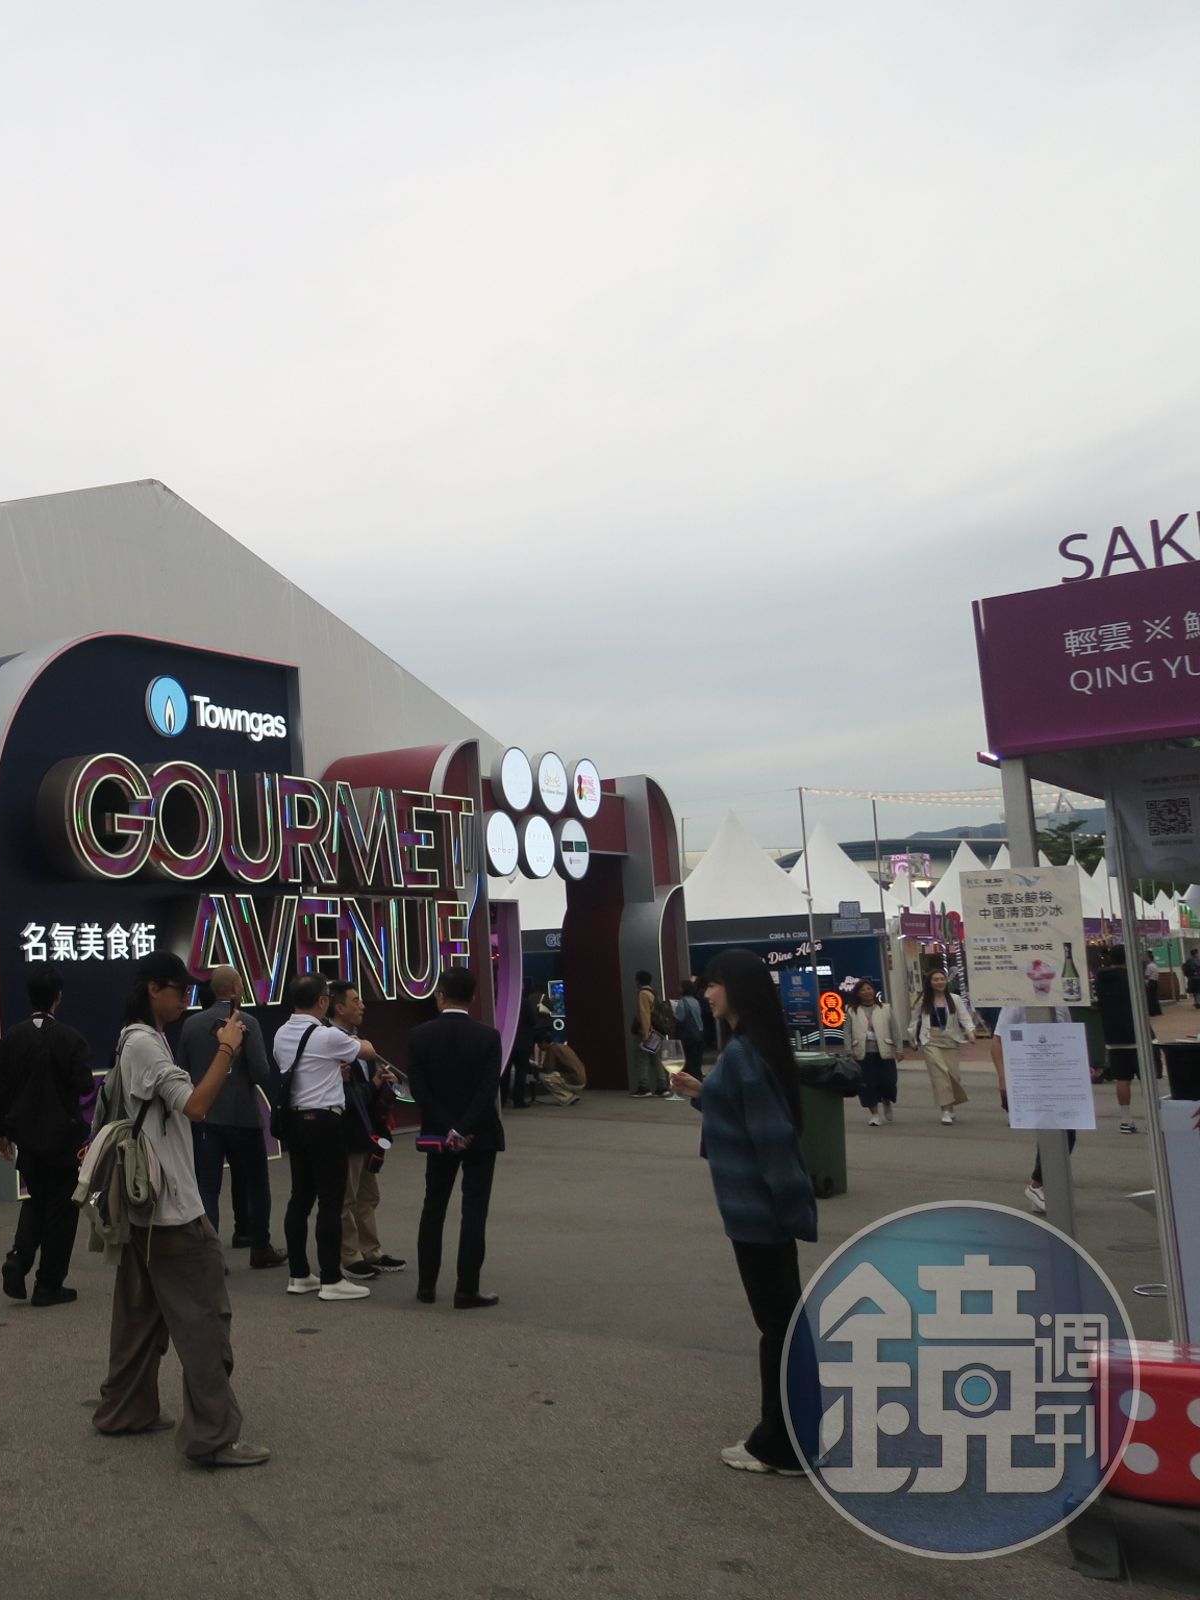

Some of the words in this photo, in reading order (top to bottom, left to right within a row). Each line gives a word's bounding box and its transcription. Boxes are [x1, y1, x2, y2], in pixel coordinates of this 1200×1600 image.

[1058, 511, 1200, 583] SAK
[1063, 621, 1133, 657] 輕雲
[1069, 661, 1154, 695] QING
[191, 695, 287, 742] Towngas
[62, 752, 475, 890] GOURMET
[19, 922, 157, 962] 名氣美食街
[187, 893, 470, 1008] AVENUE
[767, 952, 793, 965] Dine
